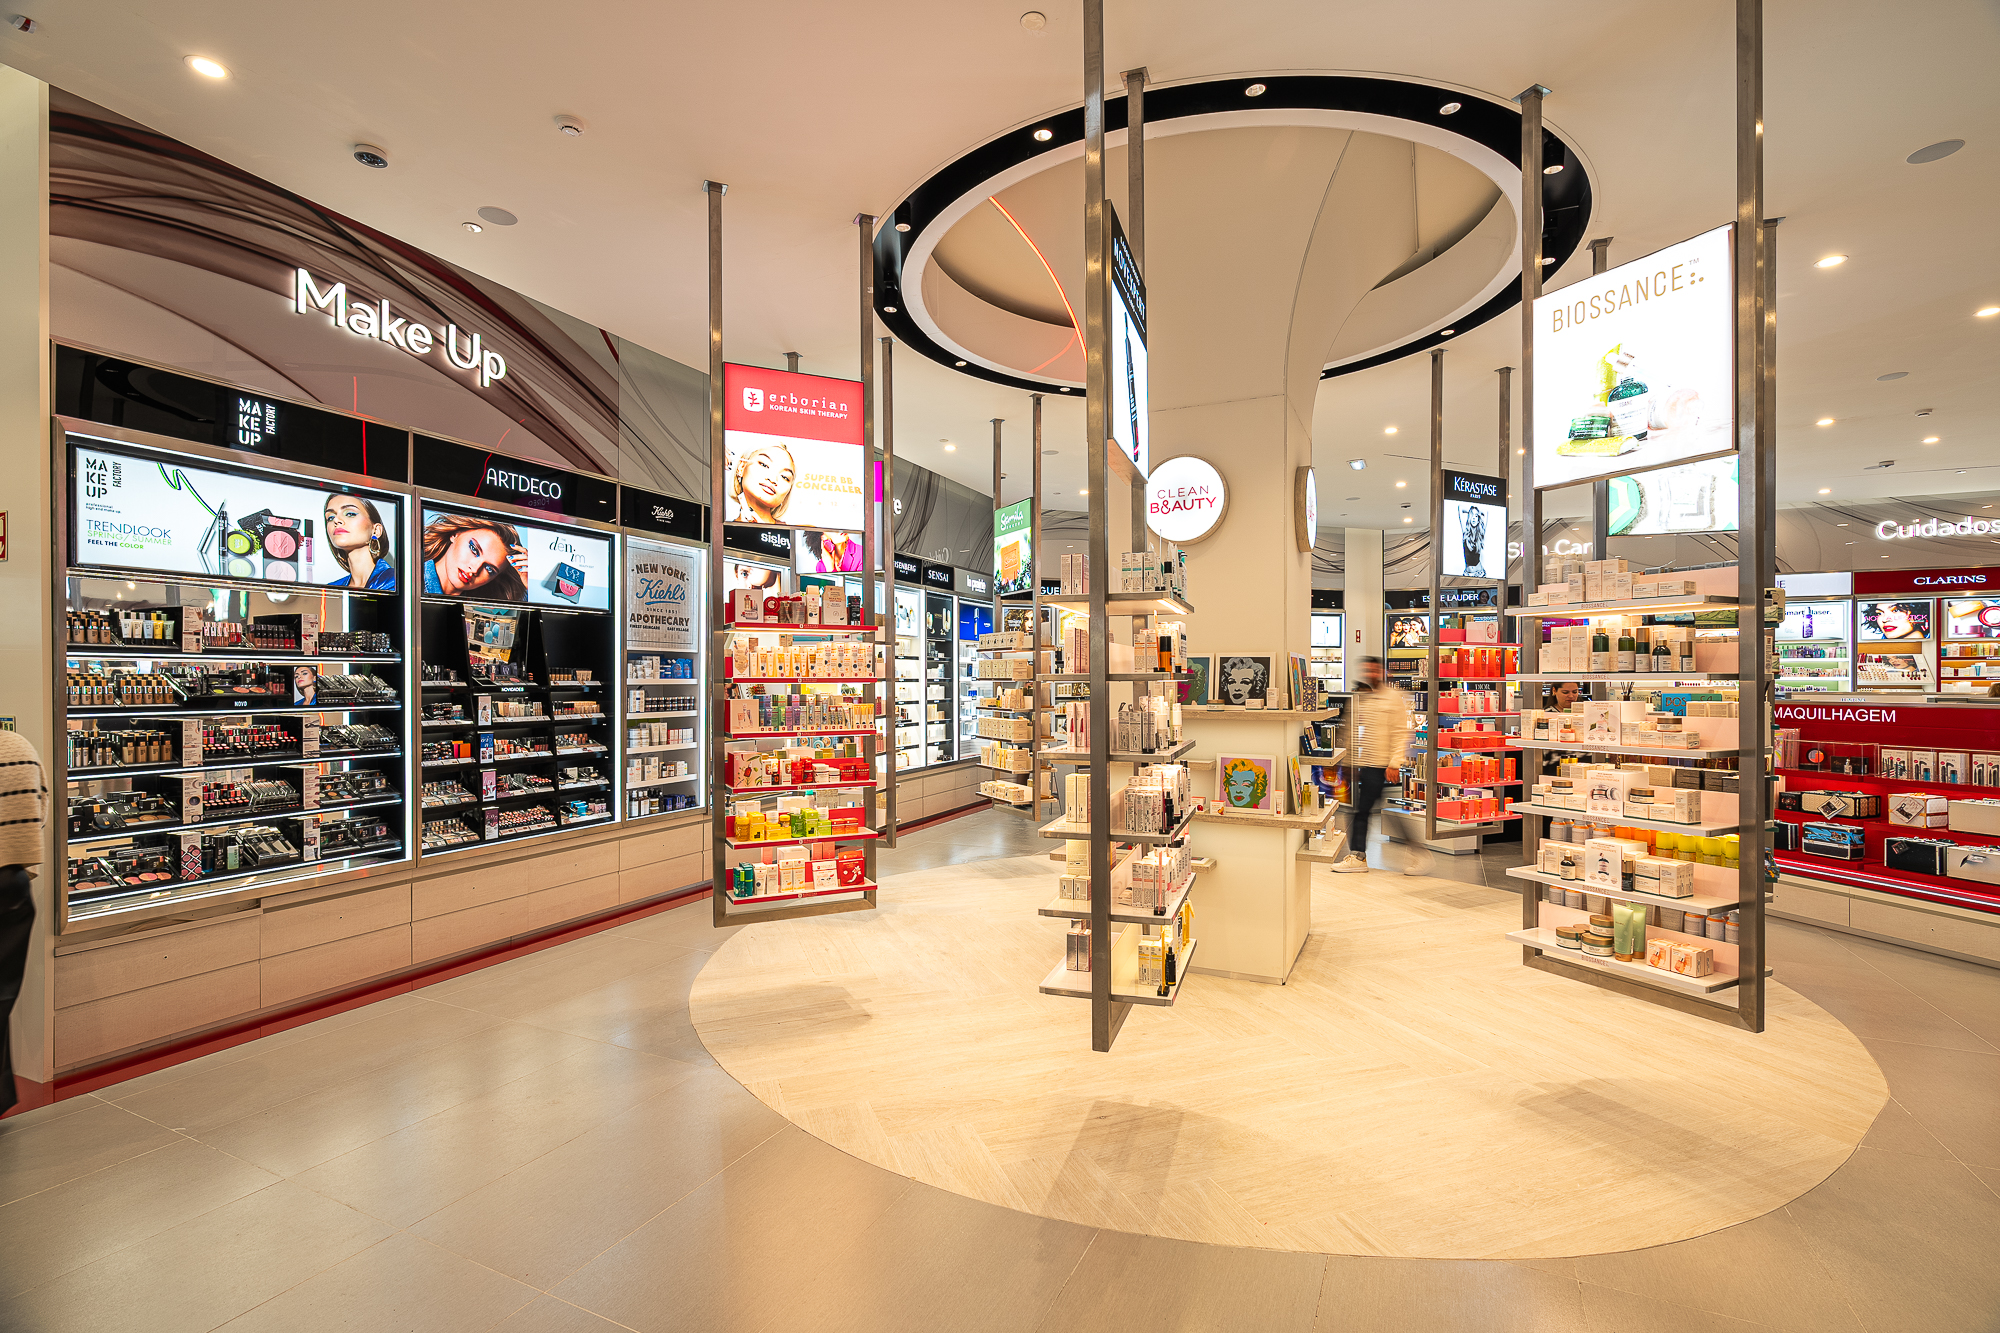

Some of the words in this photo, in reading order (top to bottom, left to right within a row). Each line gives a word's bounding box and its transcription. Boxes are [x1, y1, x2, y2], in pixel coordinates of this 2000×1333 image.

[1552, 263, 1684, 333] BIOSSANCE
[296, 267, 434, 355] Make
[445, 323, 508, 388] Up
[769, 392, 848, 412] erborian
[265, 403, 276, 435] FACTORY
[769, 404, 798, 414] KOREAN
[799, 407, 816, 416] SKIN
[817, 410, 848, 420] THERAPY
[238, 429, 262, 446] UP
[112, 461, 122, 488] FACTORY
[804, 473, 837, 483] SUPER
[840, 476, 853, 485] BB
[486, 467, 562, 499] ARTDECO
[795, 481, 863, 495] CONCEALER
[1453, 476, 1498, 497] KÉRASTASE
[86, 485, 108, 498] UP
[1157, 485, 1209, 500] CLEAN
[86, 519, 172, 540] TRENDLOOK
[1878, 515, 2000, 540] Cuidados
[87, 538, 104, 546] FEEL
[119, 542, 145, 550] COLOR
[132, 534, 172, 546] SUMMER
[760, 531, 791, 550] sisley
[1554, 538, 1594, 556] Car
[635, 563, 659, 575] NEW
[660, 564, 687, 583] YORK
[893, 560, 917, 573] ISENBERG
[927, 569, 949, 583] SENSAI
[1913, 574, 1988, 586] CLARINS
[635, 577, 686, 601] Kiehl's
[1040, 586, 1062, 596] GUE
[1446, 593, 1480, 602] LAUDER
[629, 613, 690, 627] APOTHECARY
[1773, 707, 1897, 723] MAQUILHAGEM
